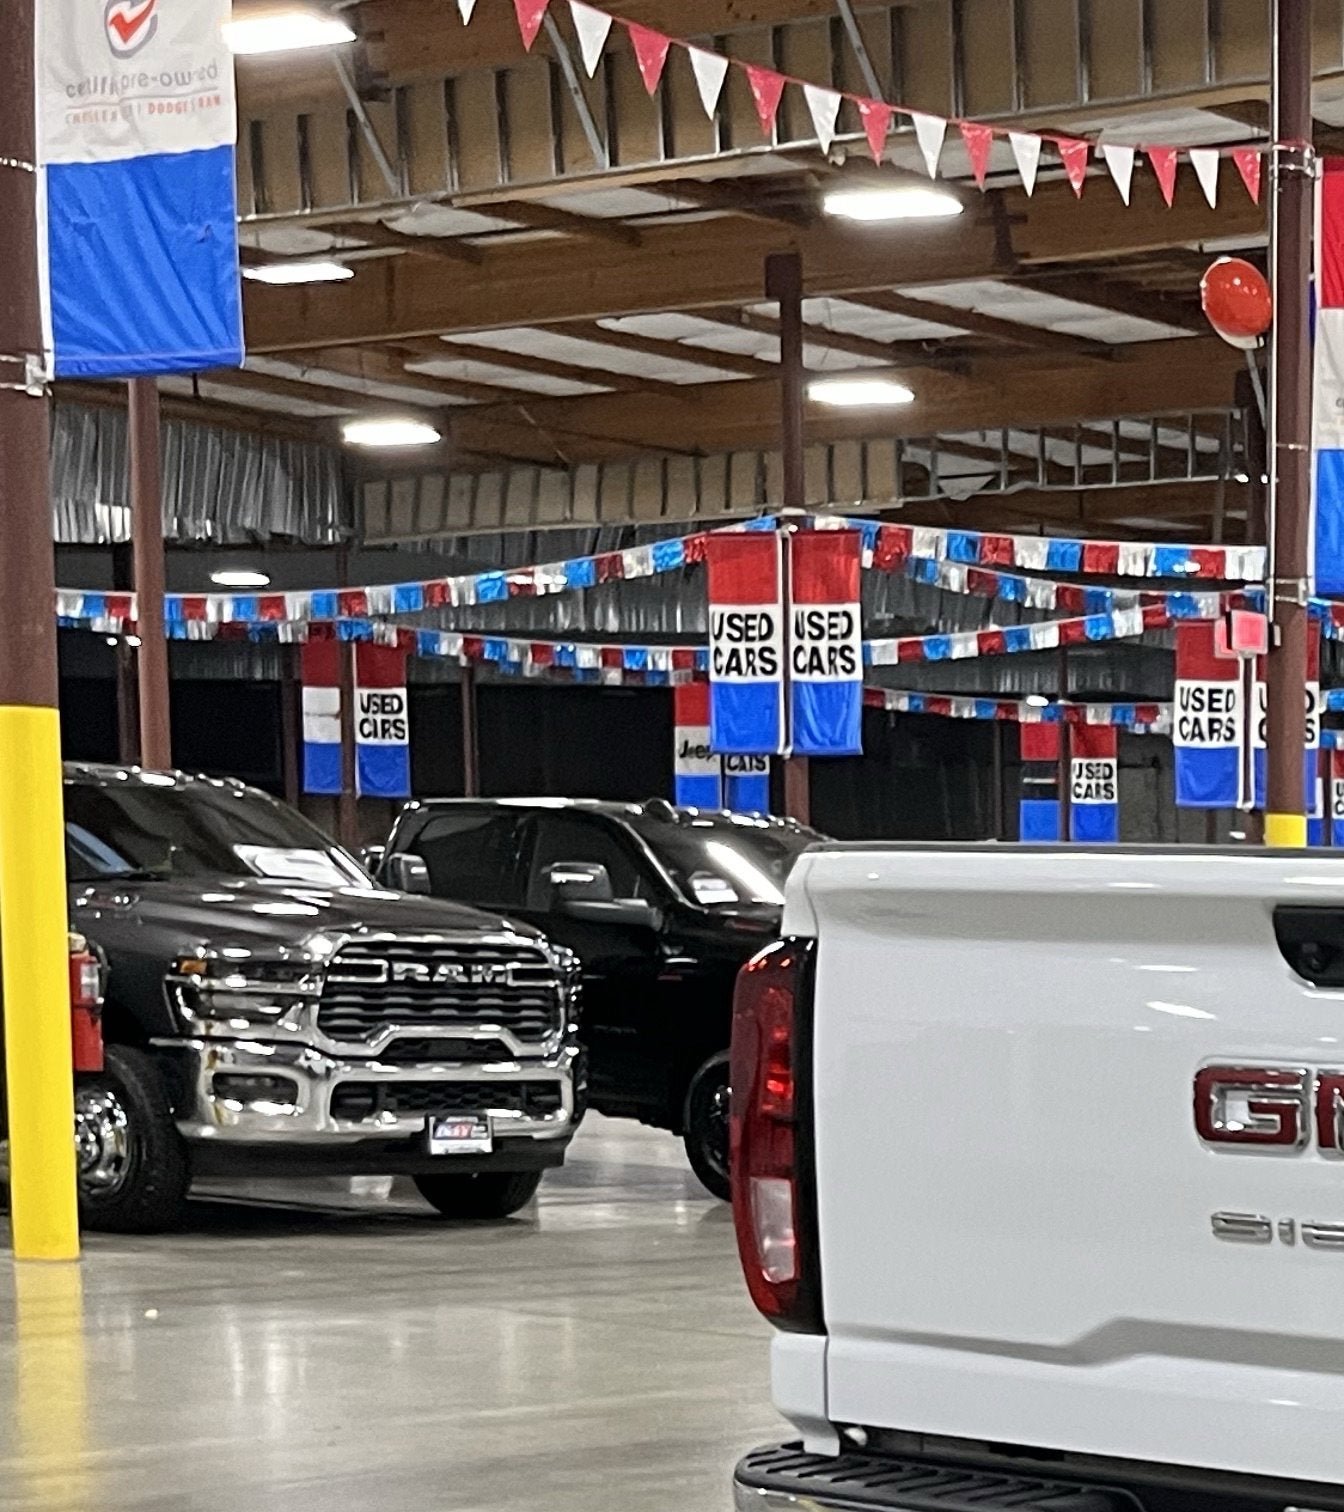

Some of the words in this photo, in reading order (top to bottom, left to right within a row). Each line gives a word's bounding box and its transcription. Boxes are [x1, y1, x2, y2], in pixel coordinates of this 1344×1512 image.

[712, 612, 775, 643] USED
[795, 610, 854, 641] USED
[713, 646, 778, 677] CARS
[793, 645, 856, 676] CARS
[360, 693, 404, 715] USED
[1180, 686, 1236, 713] USED
[1179, 716, 1236, 743] CARS
[1073, 762, 1114, 780] USED
[1073, 782, 1115, 800] CARS
[391, 961, 507, 984] RAM
